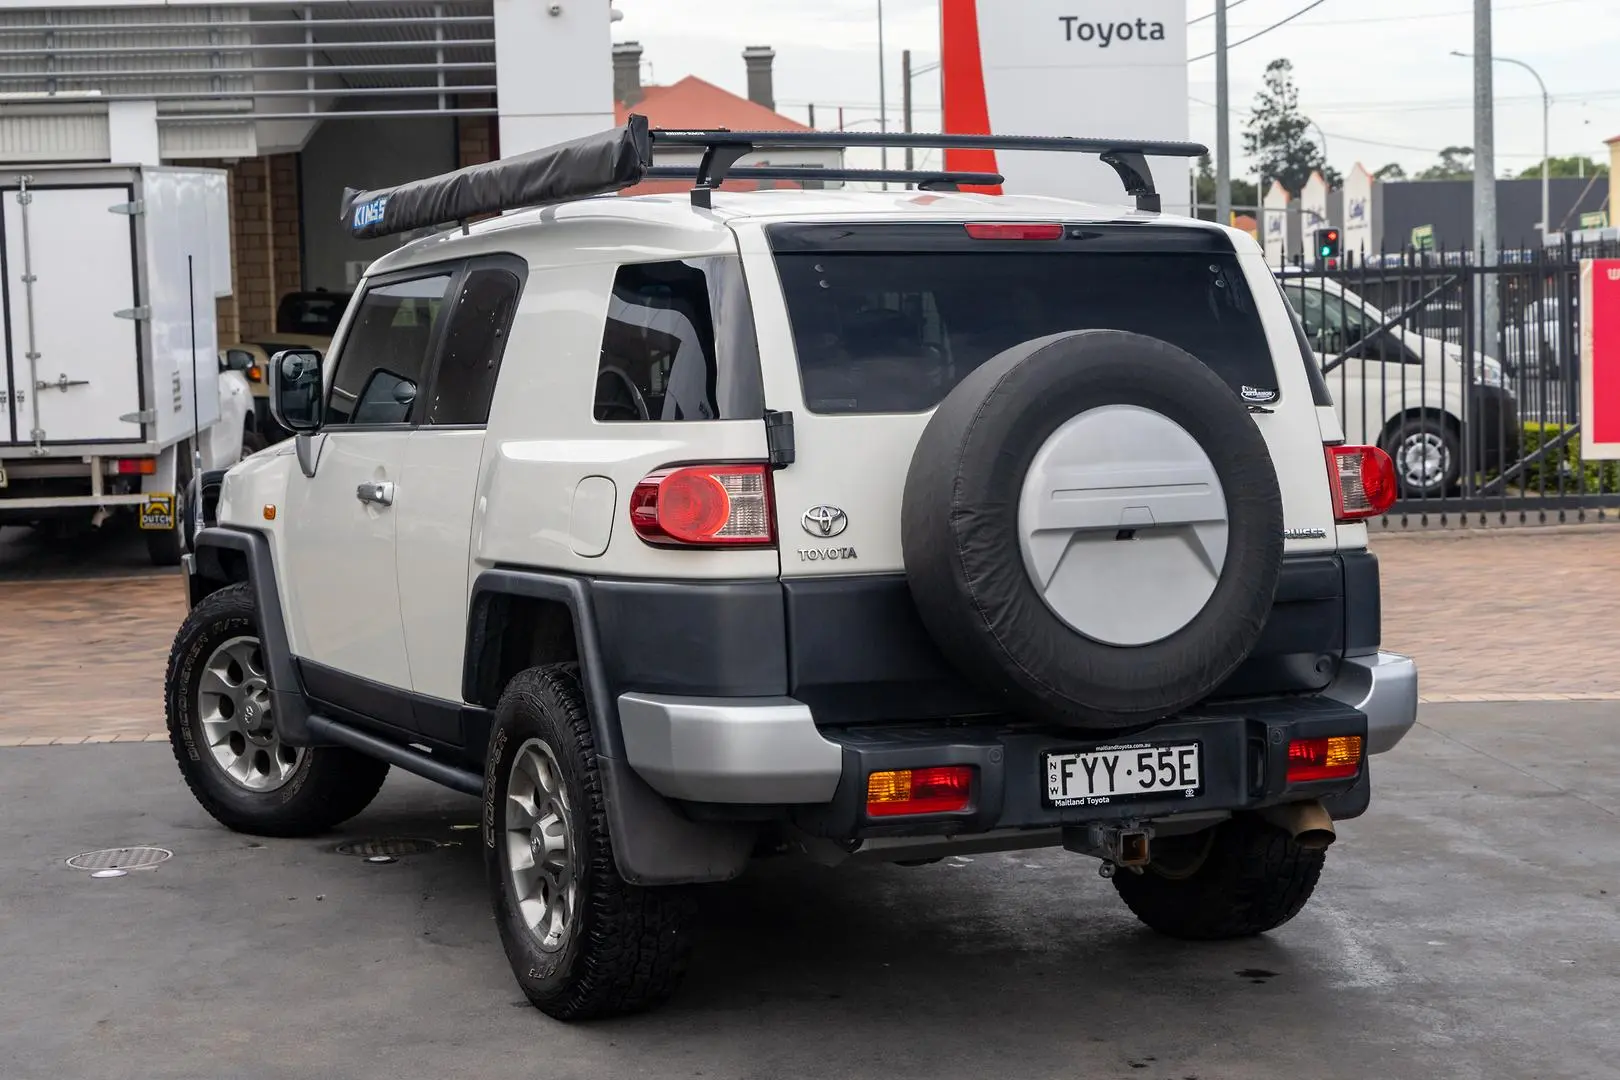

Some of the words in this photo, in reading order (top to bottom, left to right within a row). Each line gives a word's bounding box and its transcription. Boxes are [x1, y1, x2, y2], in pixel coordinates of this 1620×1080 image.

[1058, 16, 1165, 47] Toyota
[798, 547, 857, 561] TOYOTA
[1095, 742, 1152, 752] maitlandtoyota.com.au
[1055, 797, 1085, 808] Maitland
[1087, 796, 1110, 806] Toyota
